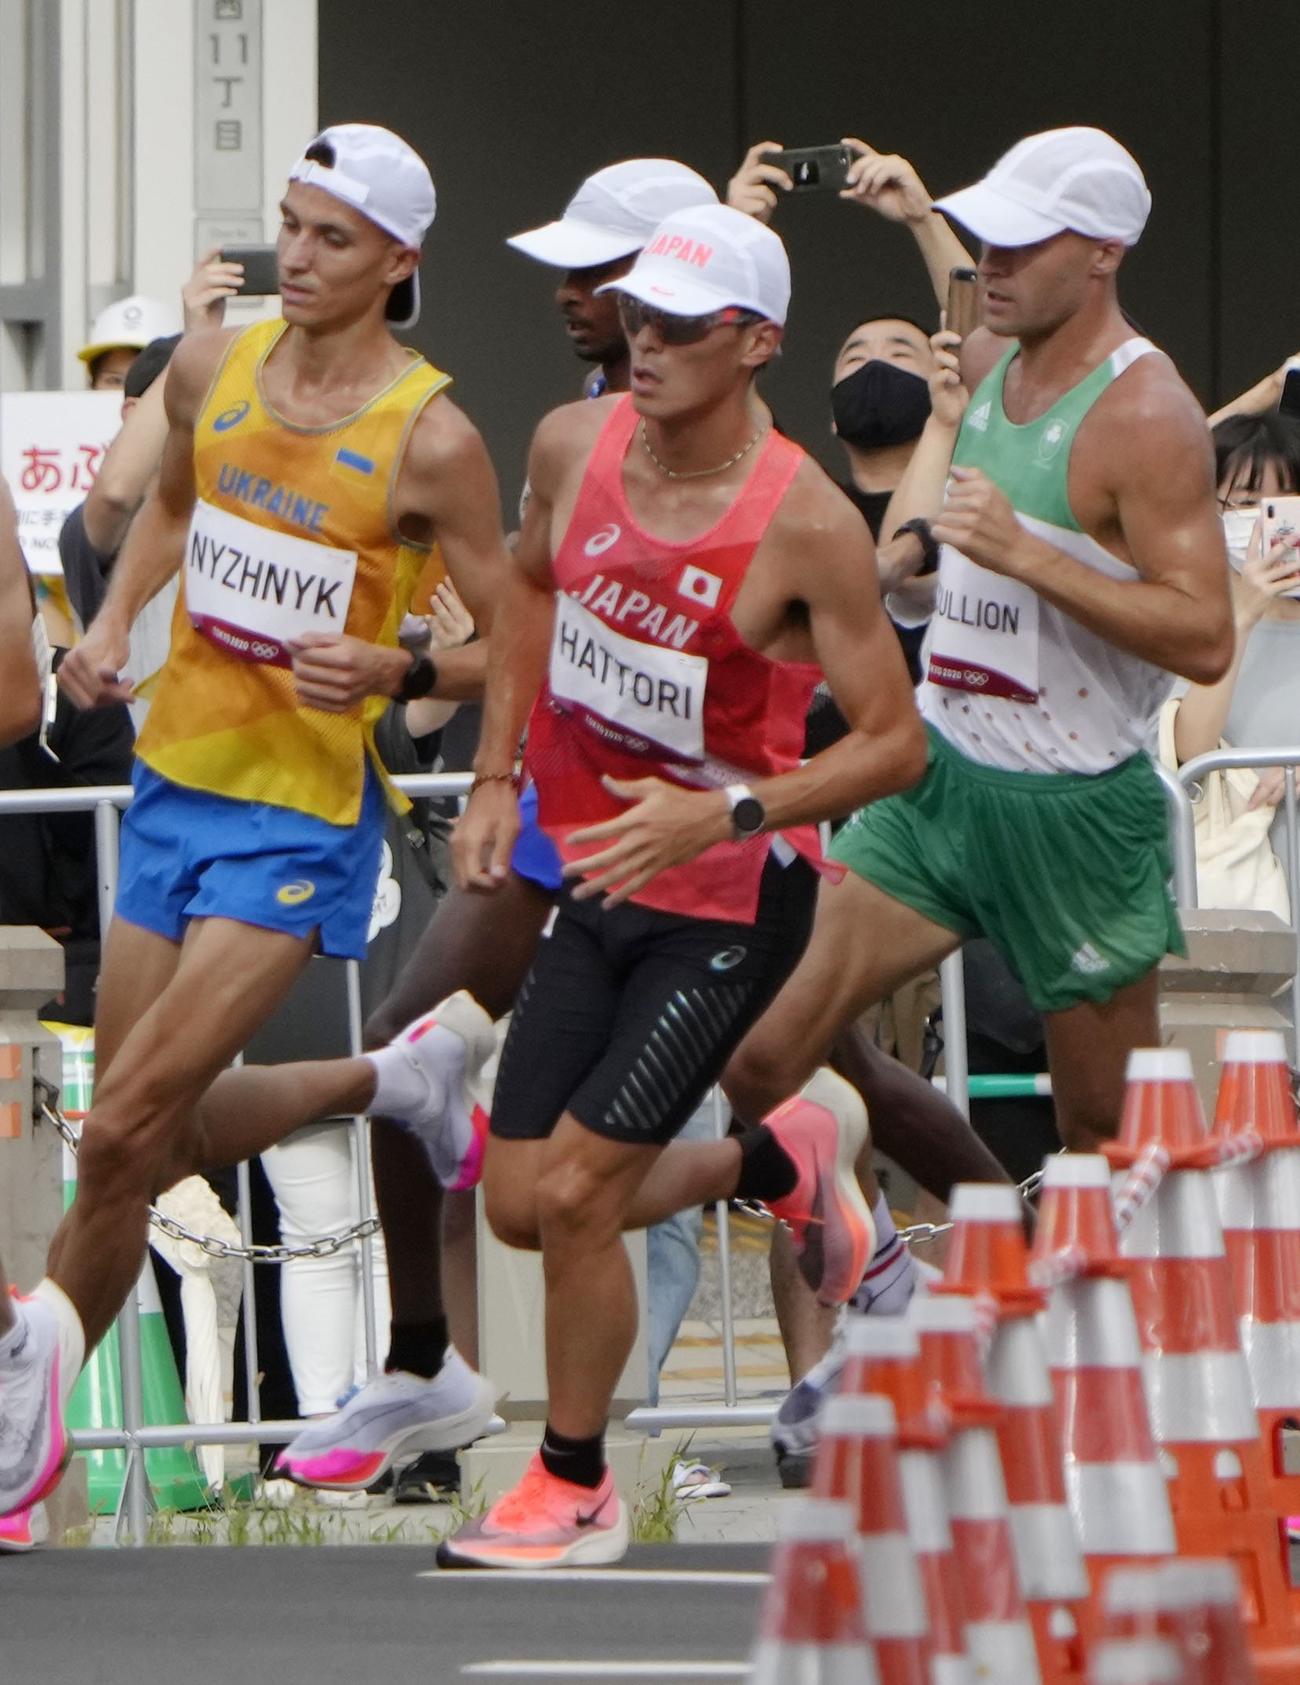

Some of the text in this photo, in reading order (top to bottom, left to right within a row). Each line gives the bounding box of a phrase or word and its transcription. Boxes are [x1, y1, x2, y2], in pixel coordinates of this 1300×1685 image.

[218, 463, 330, 534] UKRAINE
[190, 529, 343, 618] NYZHNYK
[572, 574, 699, 649] JAPAN
[560, 620, 692, 719] HATTORI
